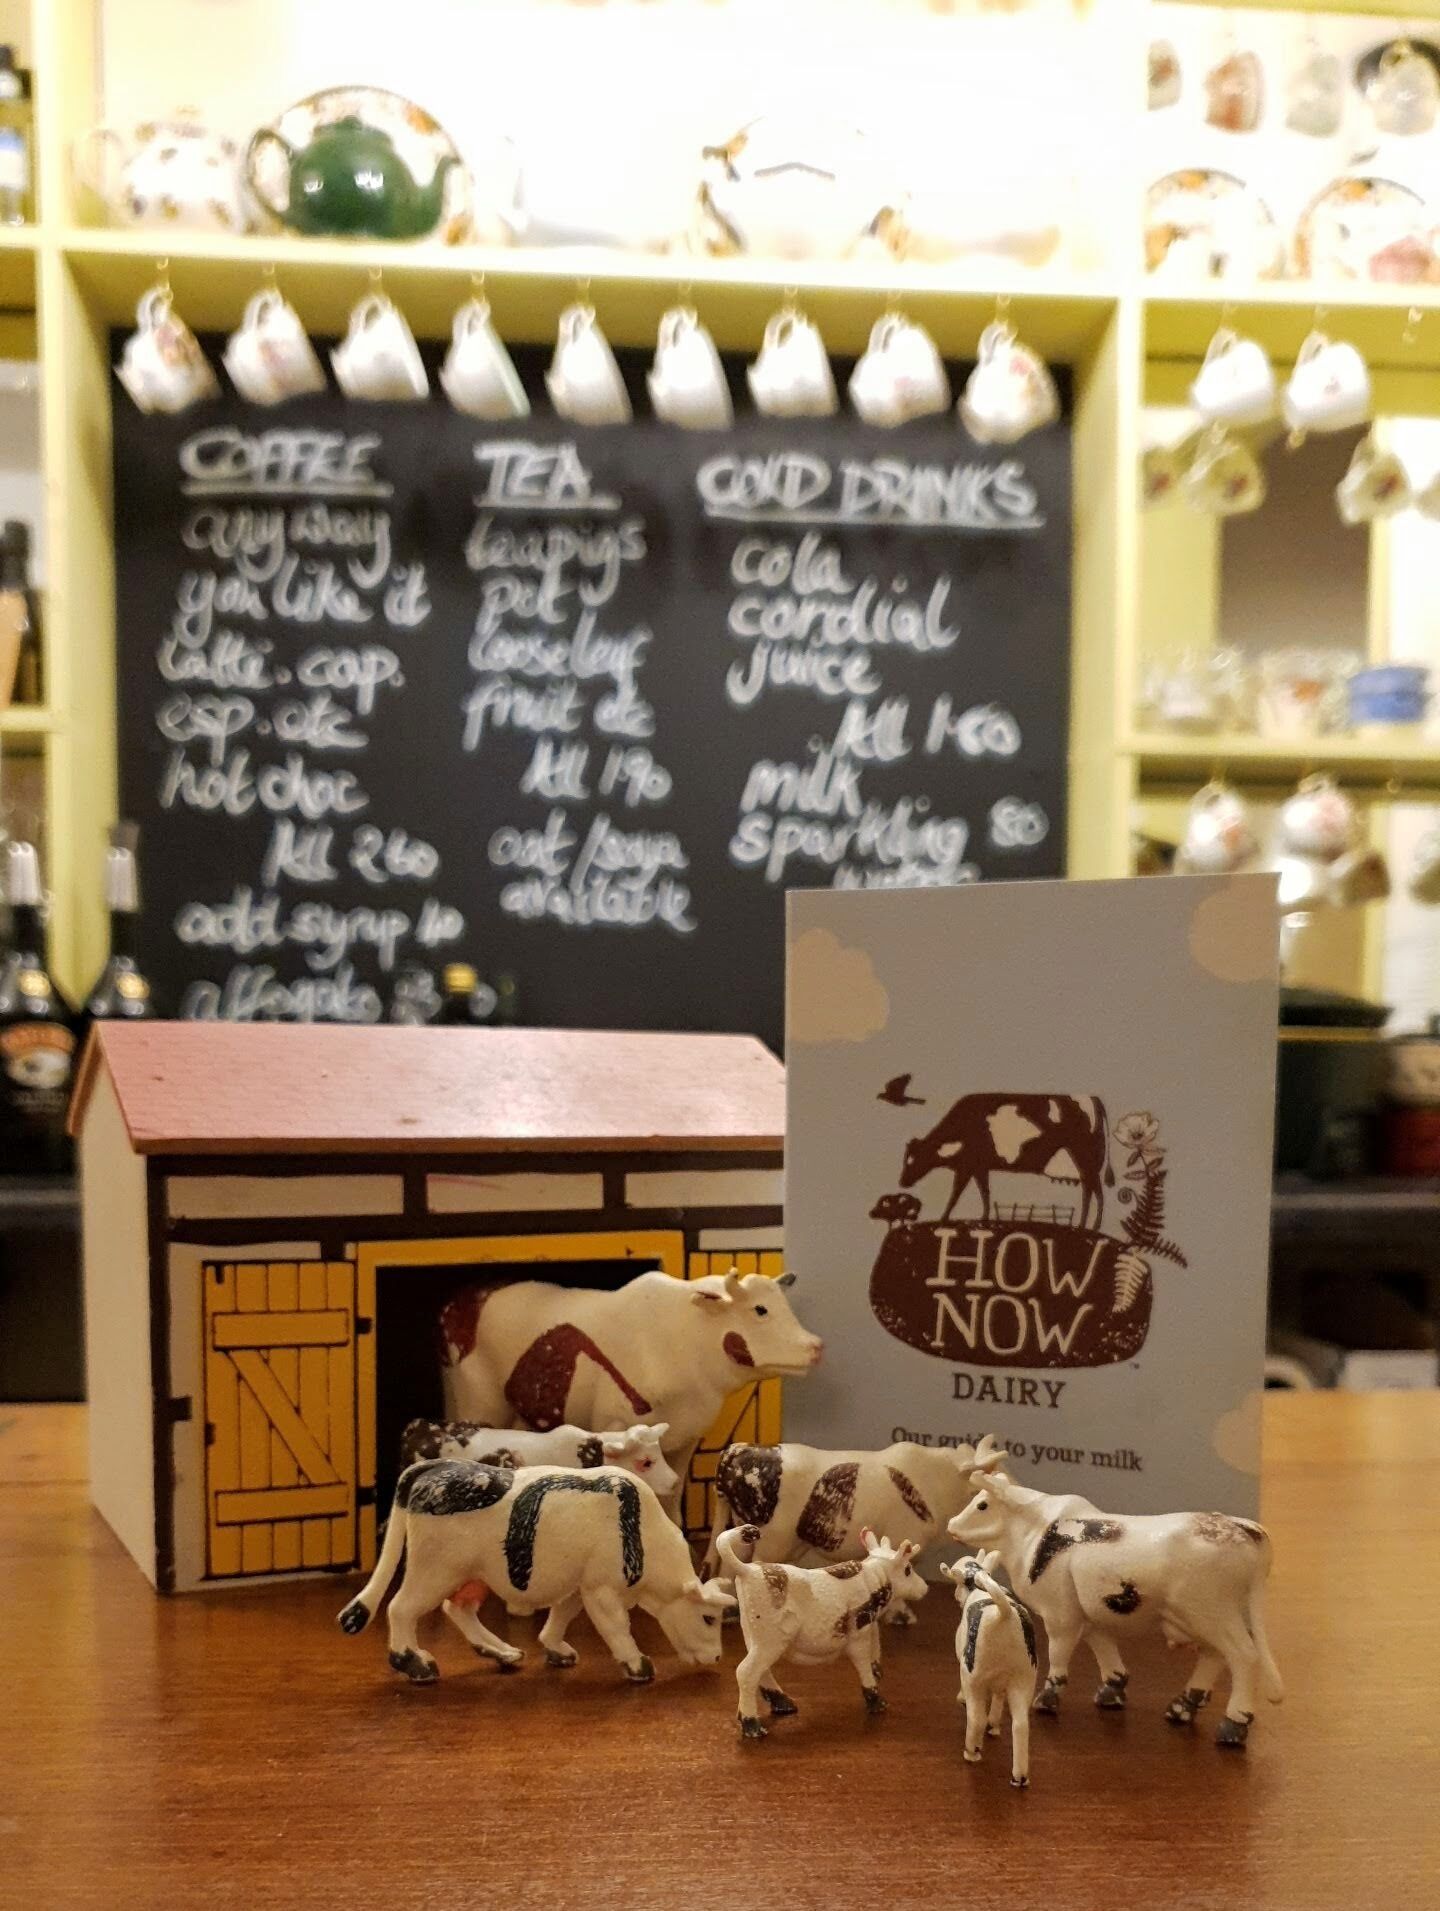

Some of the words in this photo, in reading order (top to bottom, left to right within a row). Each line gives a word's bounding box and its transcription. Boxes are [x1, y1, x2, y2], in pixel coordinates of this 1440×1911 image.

[178, 425, 384, 483] COFFEE
[473, 440, 594, 500] TEA
[696, 451, 834, 508] COLD
[838, 456, 1040, 526] DRINKS
[730, 530, 853, 596] cola
[172, 566, 269, 651] you
[271, 552, 374, 624] like
[383, 560, 433, 627] it
[727, 573, 962, 653] cordial
[725, 640, 883, 706] juice
[461, 672, 586, 752] fruit
[830, 692, 914, 763] All
[158, 746, 257, 816] hot
[256, 750, 372, 820] choc
[519, 735, 592, 801] All
[738, 734, 865, 816] milk
[261, 816, 341, 889] All
[174, 883, 285, 955] add
[283, 900, 411, 972] syrup
[499, 872, 699, 934] available
[925, 1228, 1110, 1298] HOW
[930, 1292, 1095, 1356] NOW
[952, 1372, 1067, 1409] DAIRY
[891, 1425, 933, 1448] Our
[1004, 1439, 1026, 1459] to
[1031, 1443, 1085, 1466] your
[1091, 1449, 1144, 1473] milk
